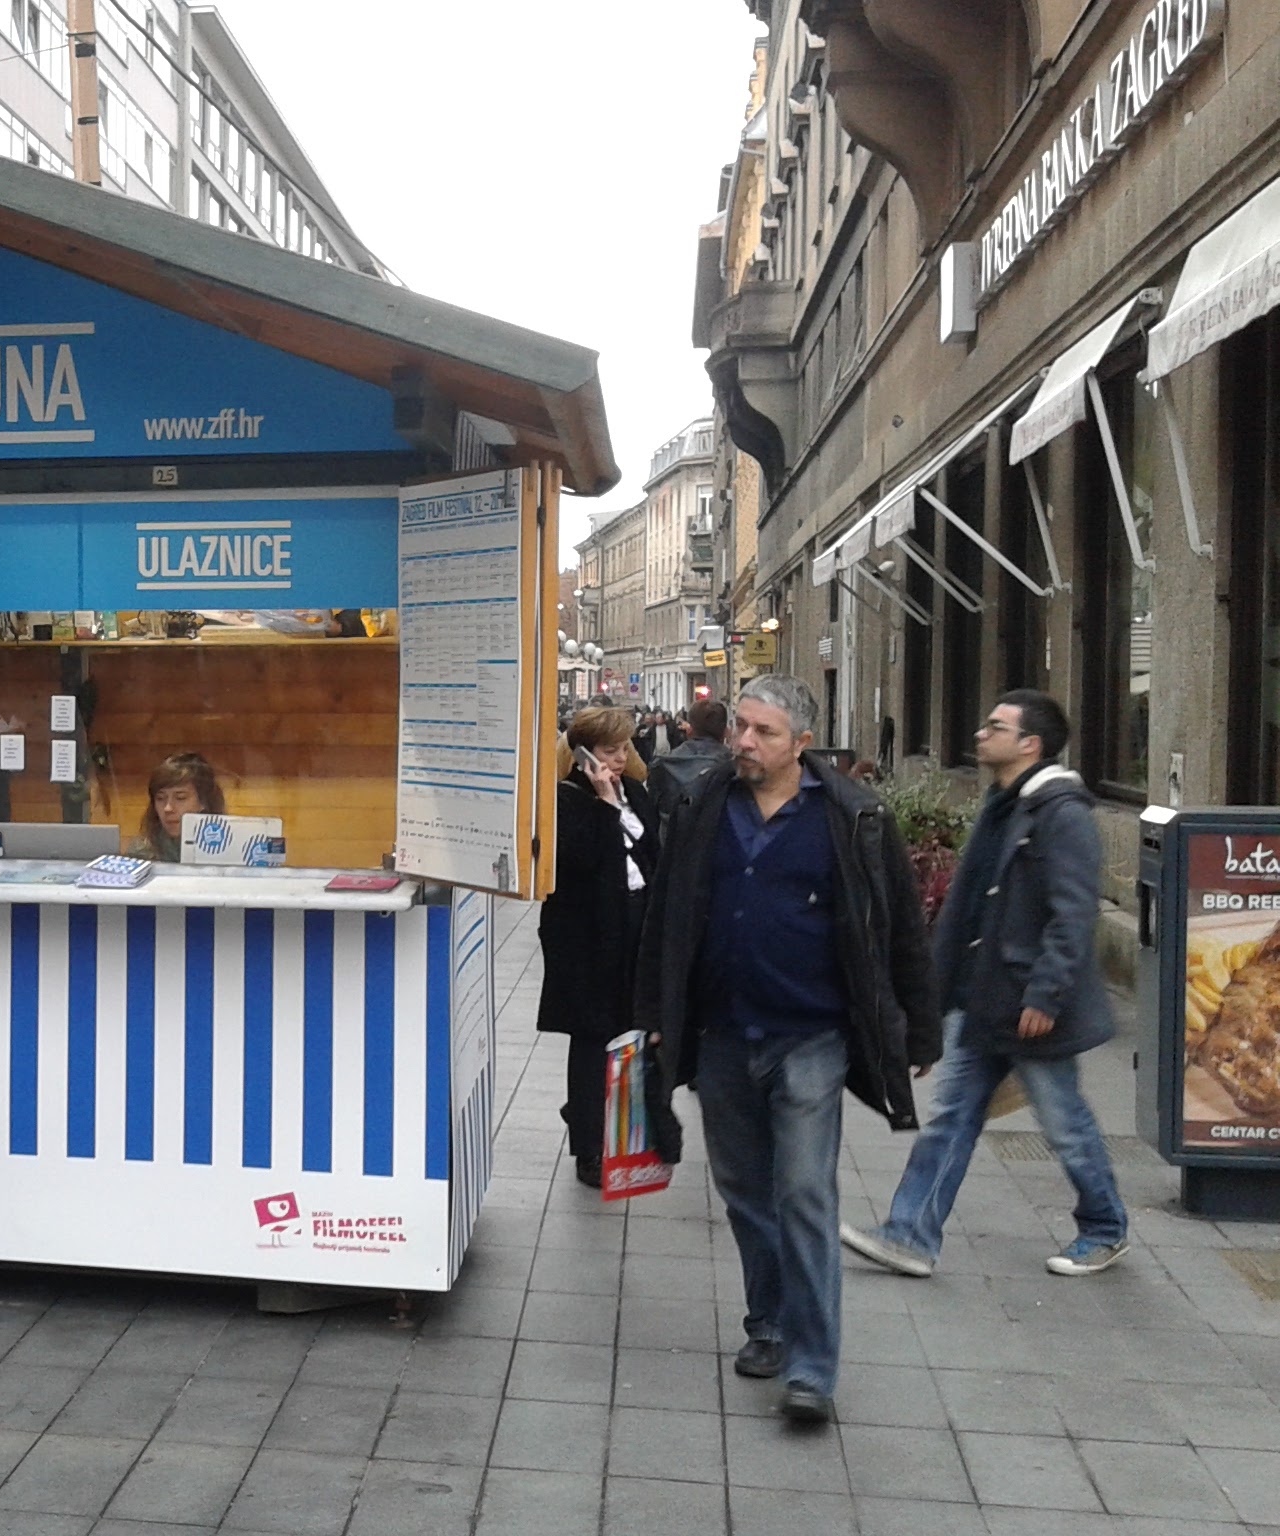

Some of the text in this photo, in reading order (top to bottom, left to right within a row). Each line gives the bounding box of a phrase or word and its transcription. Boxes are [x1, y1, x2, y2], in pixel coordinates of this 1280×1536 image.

[143, 407, 265, 441] www.zff.hr
[155, 469, 175, 483] 25
[136, 534, 292, 578] ULAZNICE
[1202, 893, 1244, 909] BBQ
[1210, 1125, 1266, 1139] CENTAR
